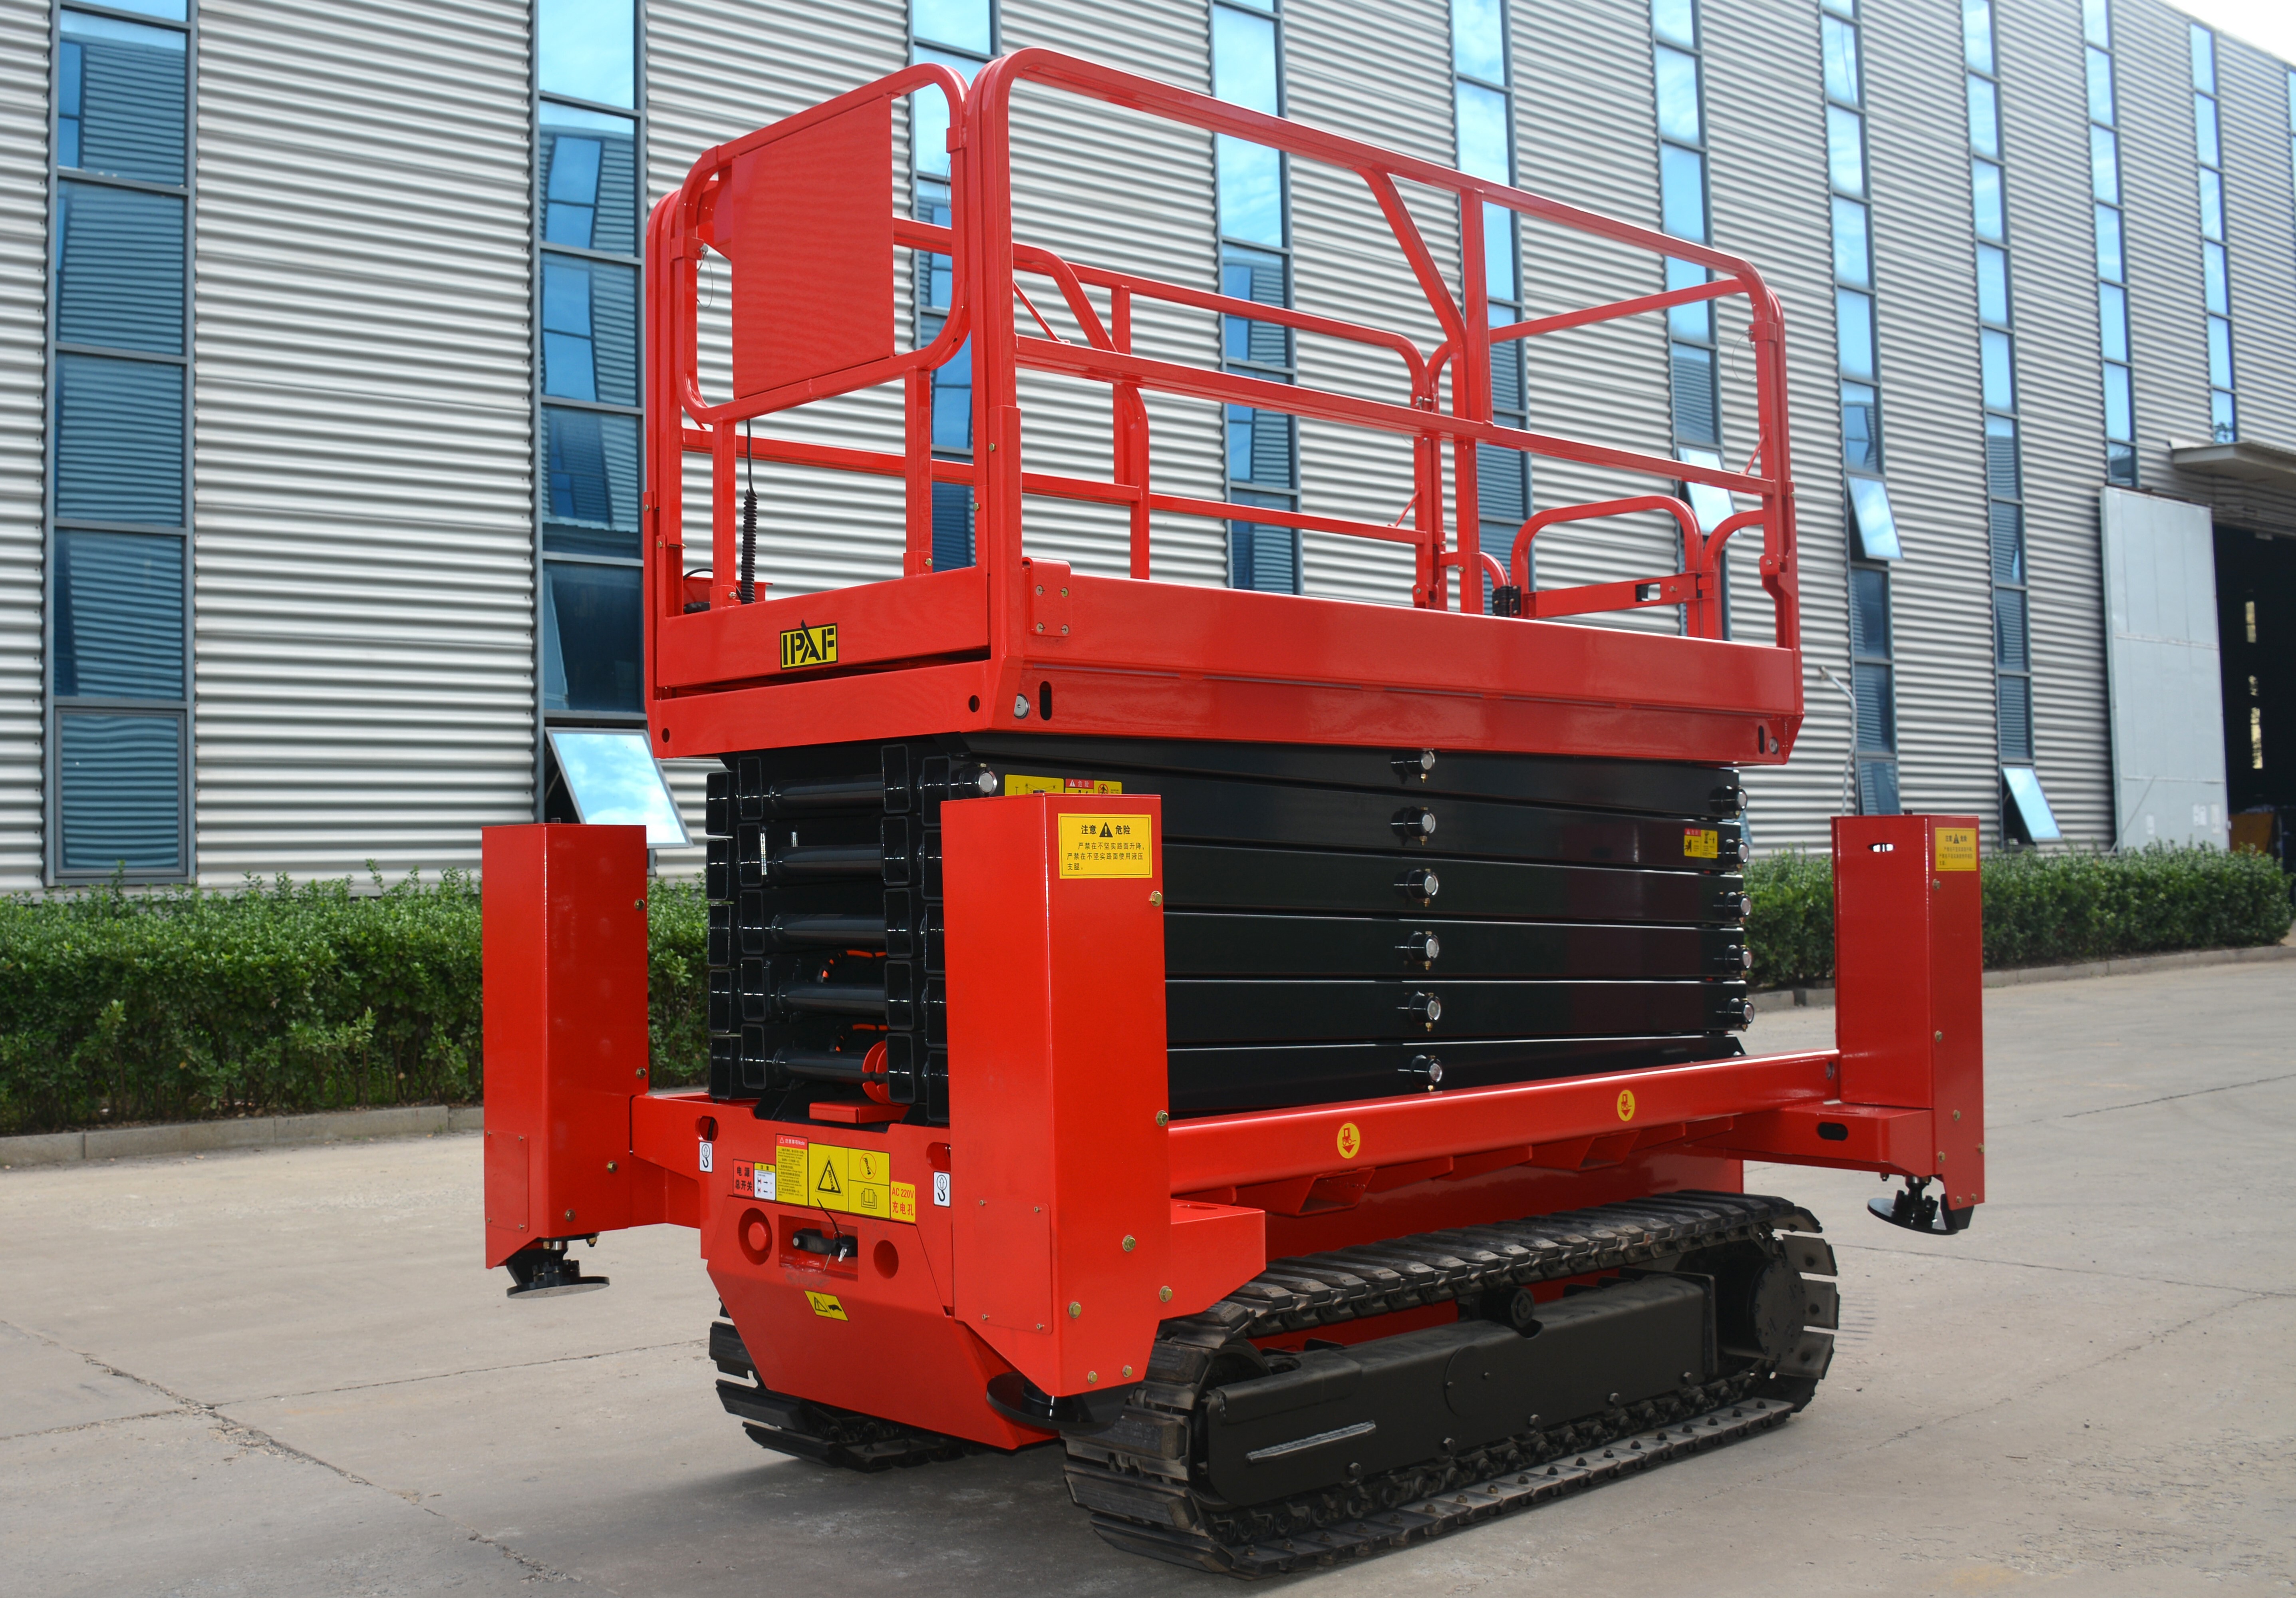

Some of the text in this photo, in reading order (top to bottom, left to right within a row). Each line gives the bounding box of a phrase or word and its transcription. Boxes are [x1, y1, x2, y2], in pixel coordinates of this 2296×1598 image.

[783, 620, 835, 666] IPAF
[1081, 825, 1131, 835] 注意 危险
[736, 1166, 750, 1178] 电源
[735, 1179, 752, 1192] 总开关
[892, 1187, 914, 1198] AC 220V
[892, 1201, 914, 1216] 充电孔
